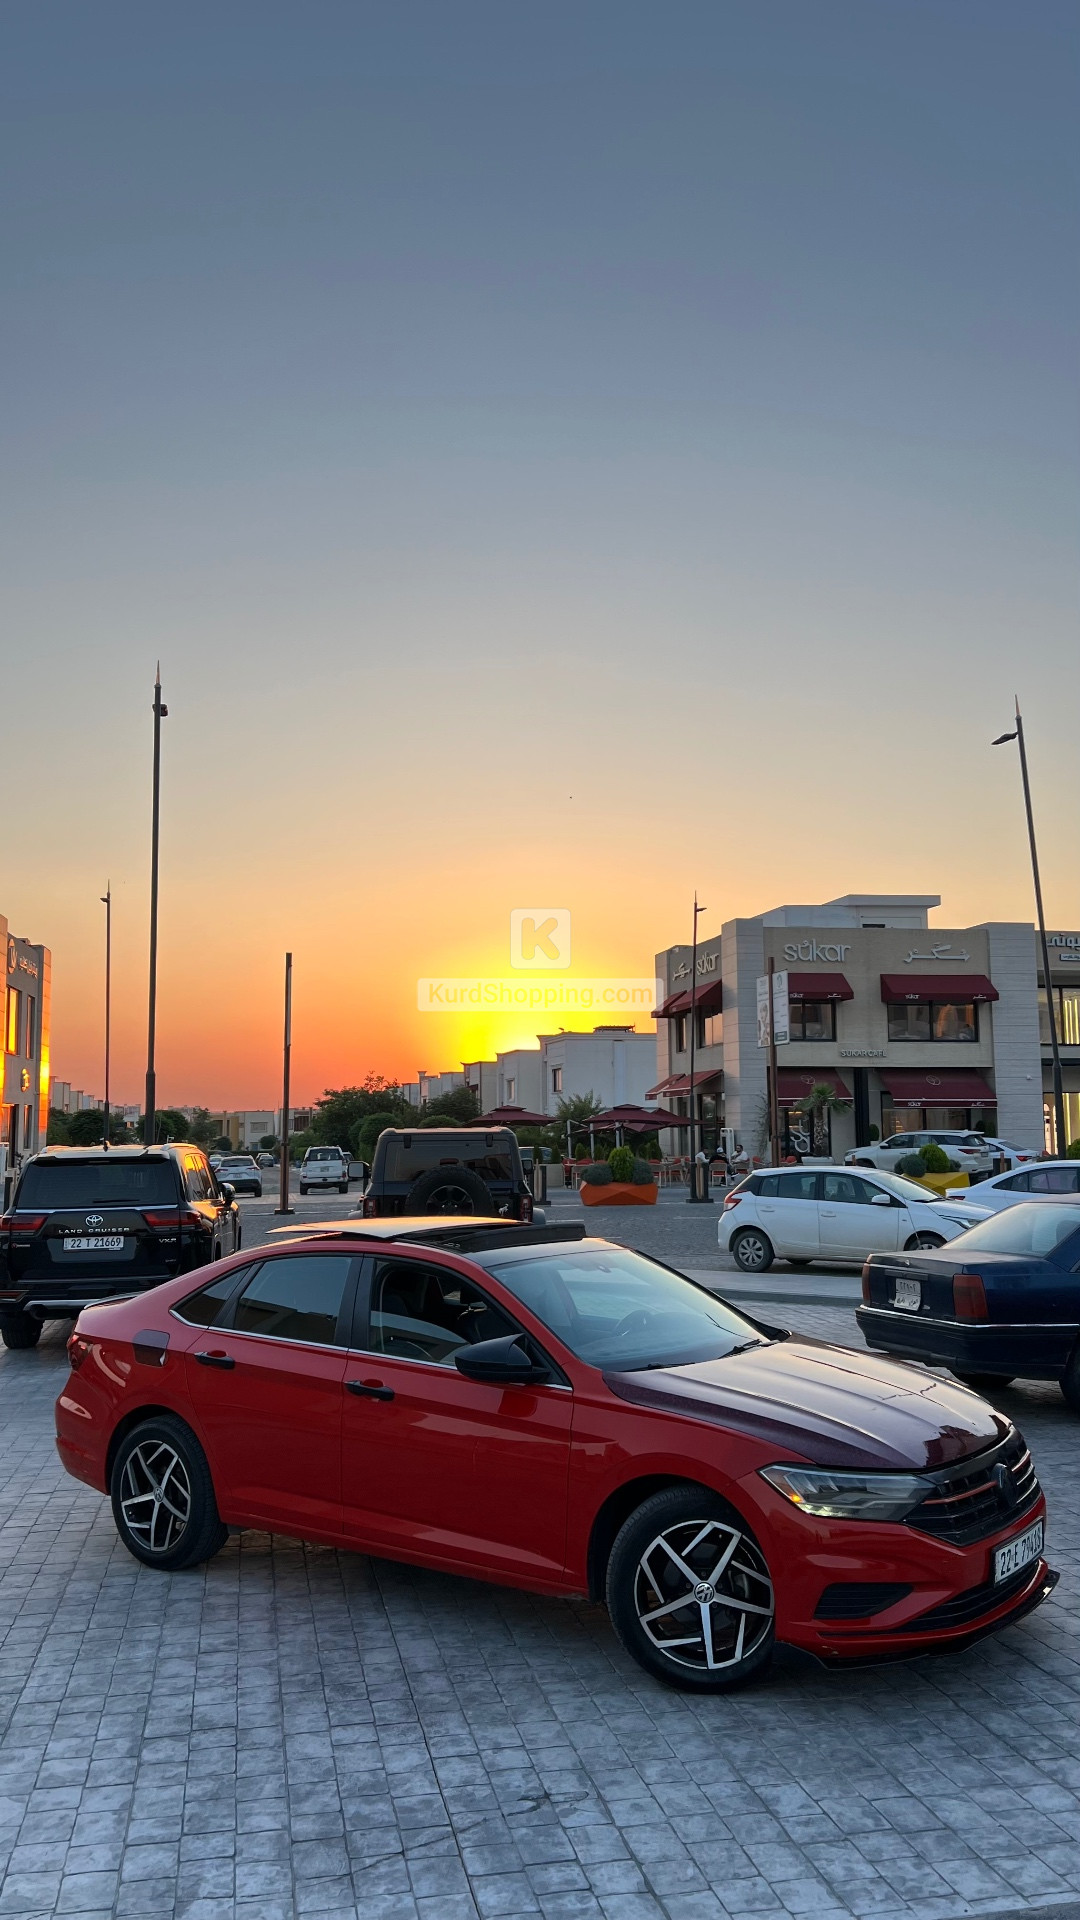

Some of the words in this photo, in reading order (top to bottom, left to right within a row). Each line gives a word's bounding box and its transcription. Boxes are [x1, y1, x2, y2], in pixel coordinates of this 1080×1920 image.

[70, 1238, 82, 1248] 22
[85, 1238, 91, 1247] T
[94, 1237, 121, 1248] 21669
[1001, 1549, 1011, 1576] 22
